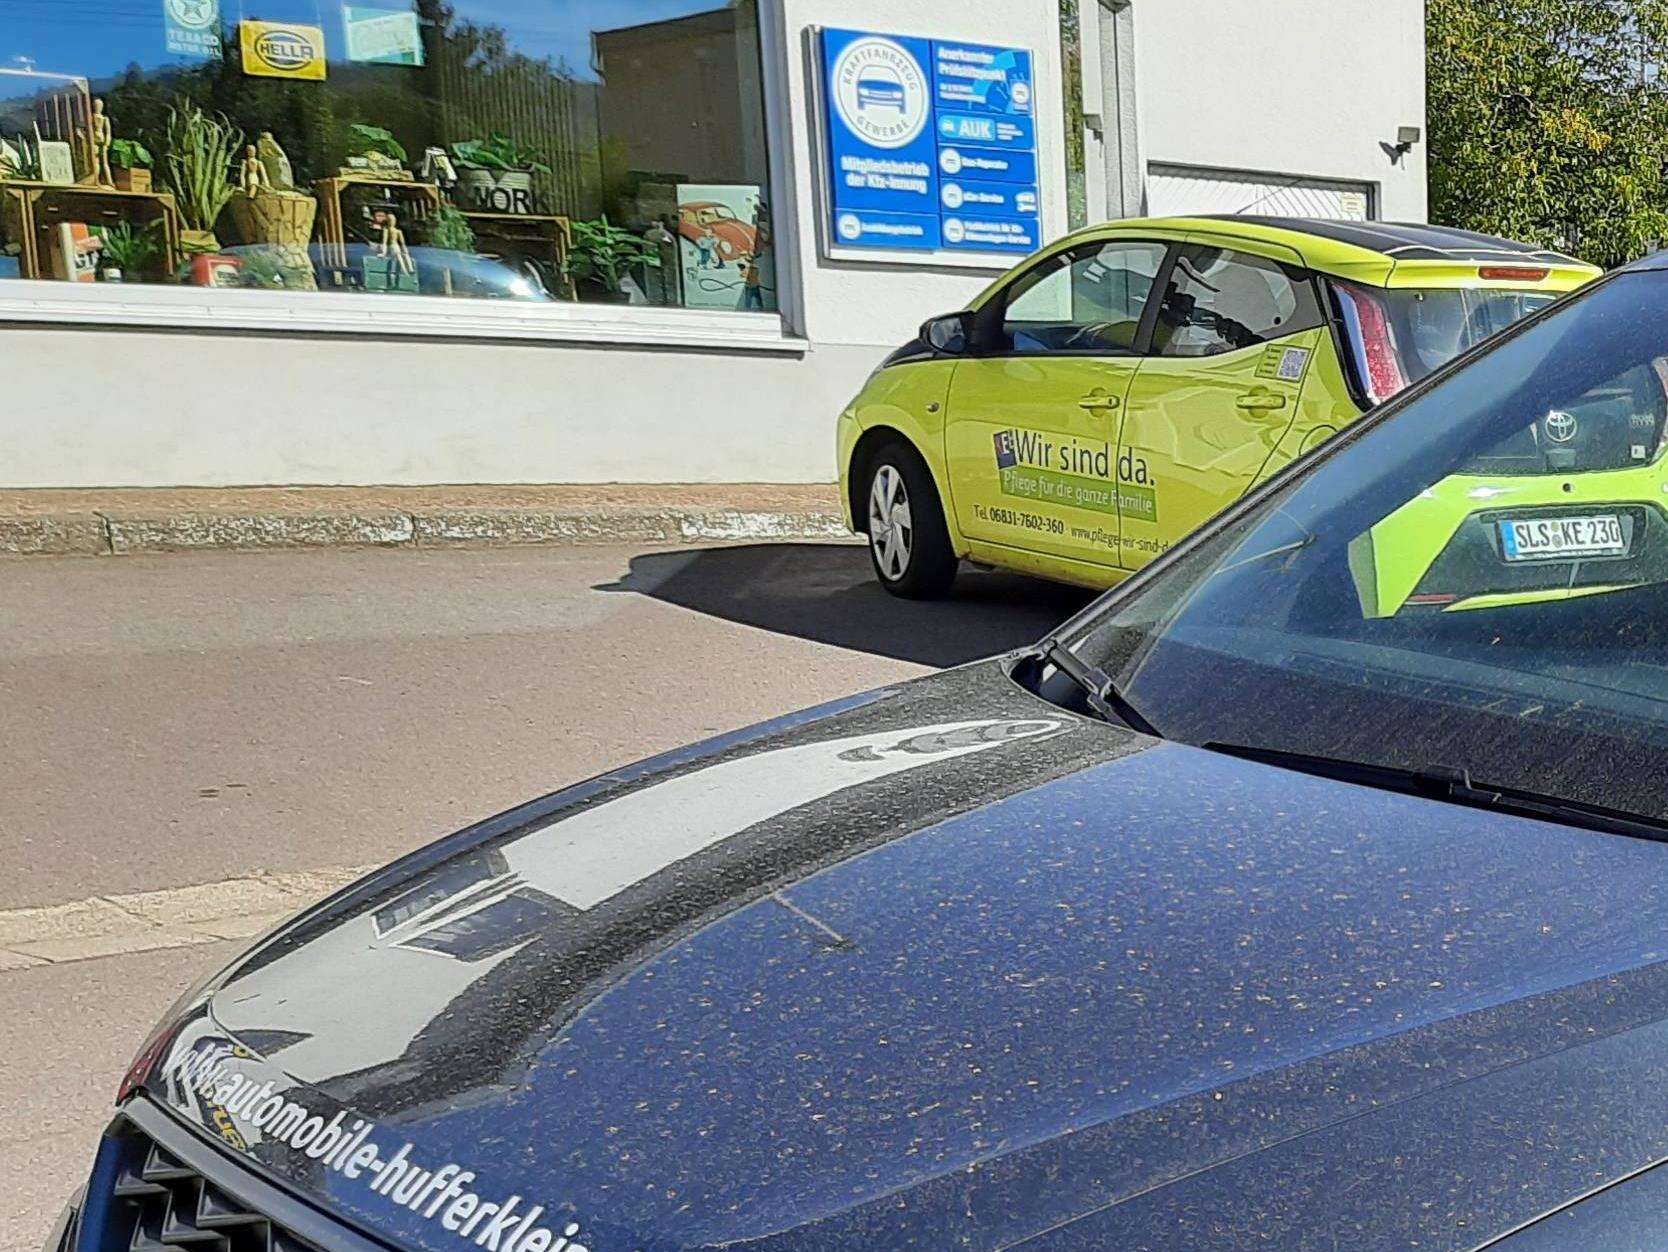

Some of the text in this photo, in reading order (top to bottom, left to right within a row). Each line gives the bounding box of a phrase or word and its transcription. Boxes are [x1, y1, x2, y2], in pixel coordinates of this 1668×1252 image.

[260, 43, 314, 60] HELLA
[856, 115, 911, 137] GEWERBE
[959, 119, 992, 139] AUK
[1015, 428, 1155, 487] Wir sind da.
[1003, 470, 1037, 495] Pflege
[1076, 487, 1108, 505] ganze
[1515, 519, 1620, 549] SLS KE 230
